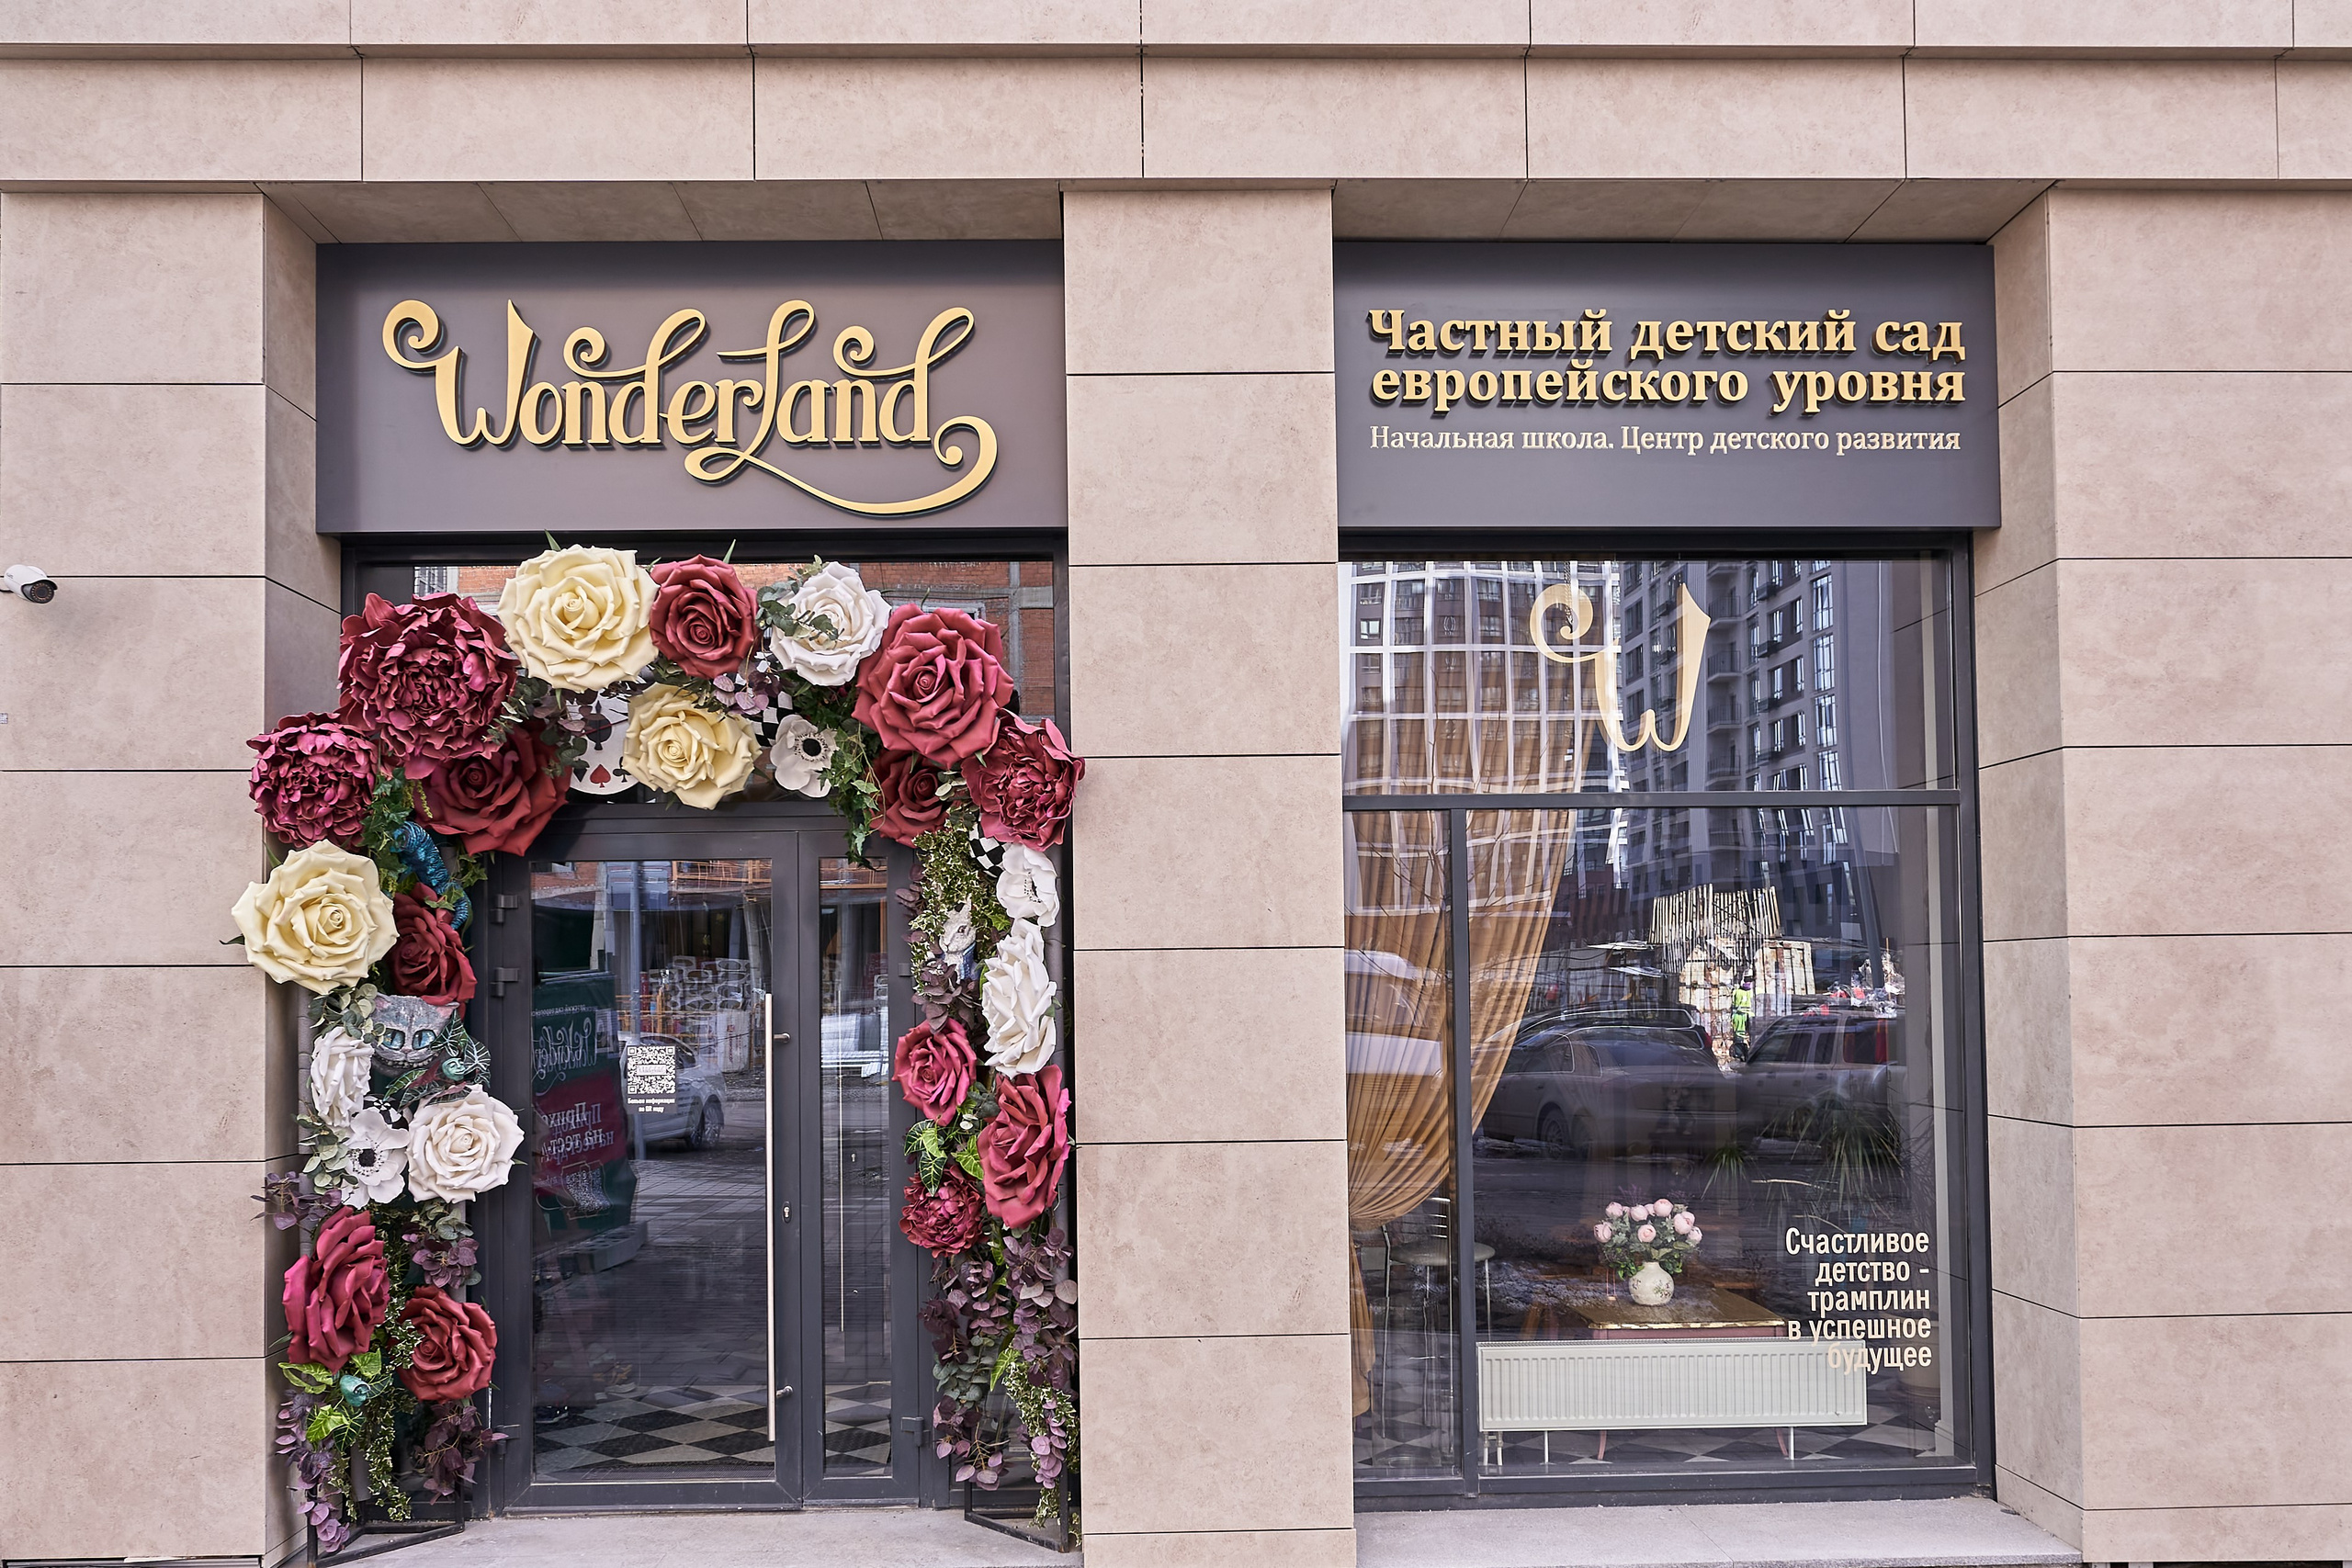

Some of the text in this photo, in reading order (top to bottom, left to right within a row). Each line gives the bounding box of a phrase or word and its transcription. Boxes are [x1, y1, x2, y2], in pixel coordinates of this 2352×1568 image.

[1368, 309, 1966, 361] Частный детский сад
[1372, 358, 1966, 413] европейского уровня
[1370, 425, 1962, 456] Начальная школа. Центр детского развития
[1785, 1227, 1929, 1255] Счастливое
[1815, 1260, 1910, 1287] детство
[1807, 1289, 1930, 1318] трамплин
[1788, 1317, 1931, 1347] в успешное
[1827, 1341, 1932, 1375] будущее
